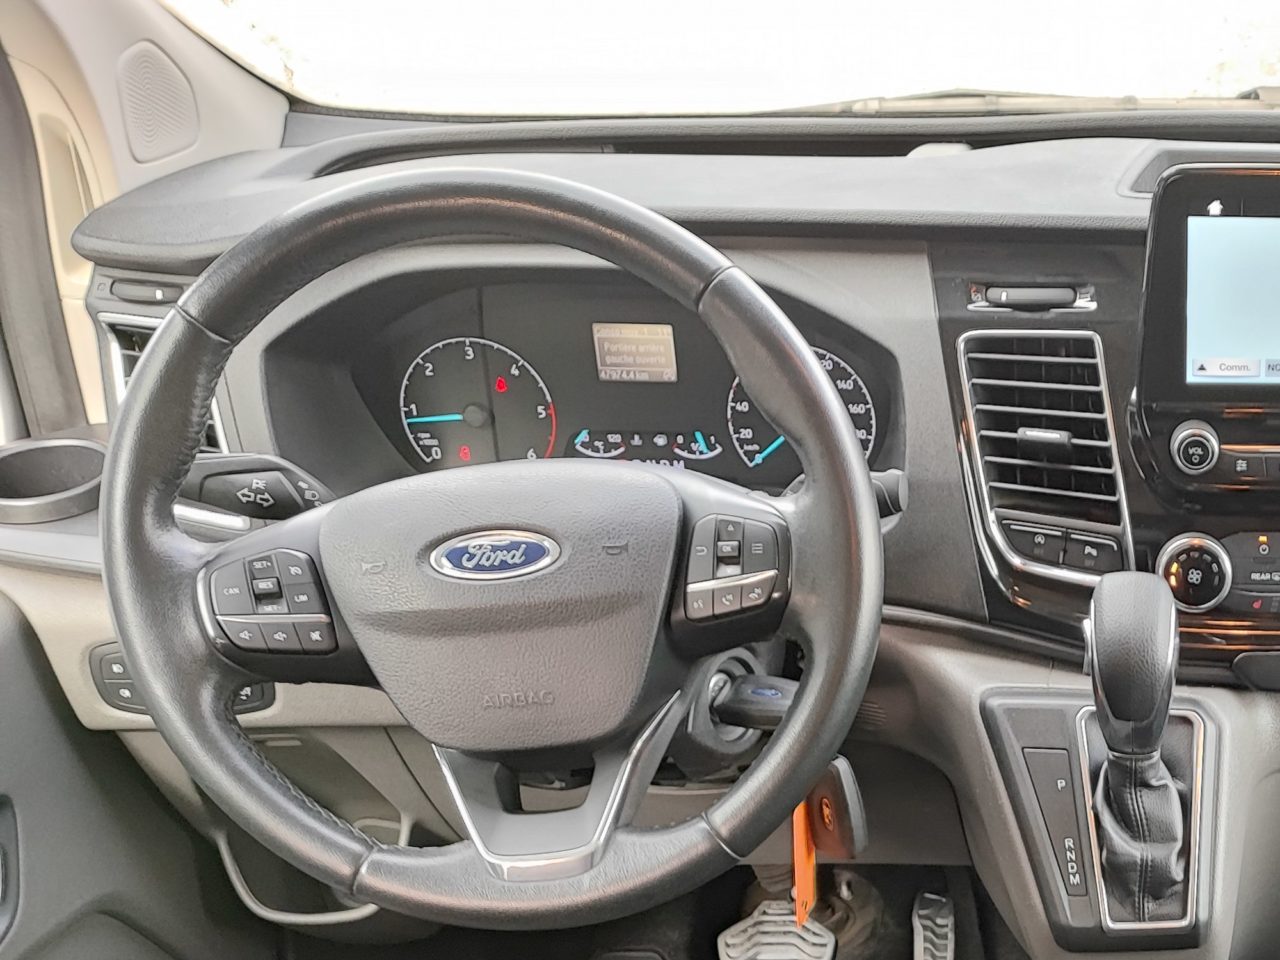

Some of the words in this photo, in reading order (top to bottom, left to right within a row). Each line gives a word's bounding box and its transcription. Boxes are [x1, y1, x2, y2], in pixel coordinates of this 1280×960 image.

[465, 347, 474, 360] 3
[424, 363, 434, 376] 2
[510, 363, 520, 377] 4
[1219, 363, 1251, 372] Comm.
[836, 379, 854, 390] 140
[409, 403, 417, 416] 1
[537, 405, 546, 418] 5
[735, 401, 749, 412] 40
[848, 403, 866, 414] 160
[740, 428, 753, 439] 20
[431, 446, 442, 460] 0
[527, 448, 537, 460] 6
[1188, 446, 1204, 455] VOL
[461, 541, 527, 568] Ford
[1251, 572, 1271, 580] REAR
[223, 587, 240, 595] CAN
[483, 691, 556, 708] AIRBAG
[1057, 779, 1066, 791] P
